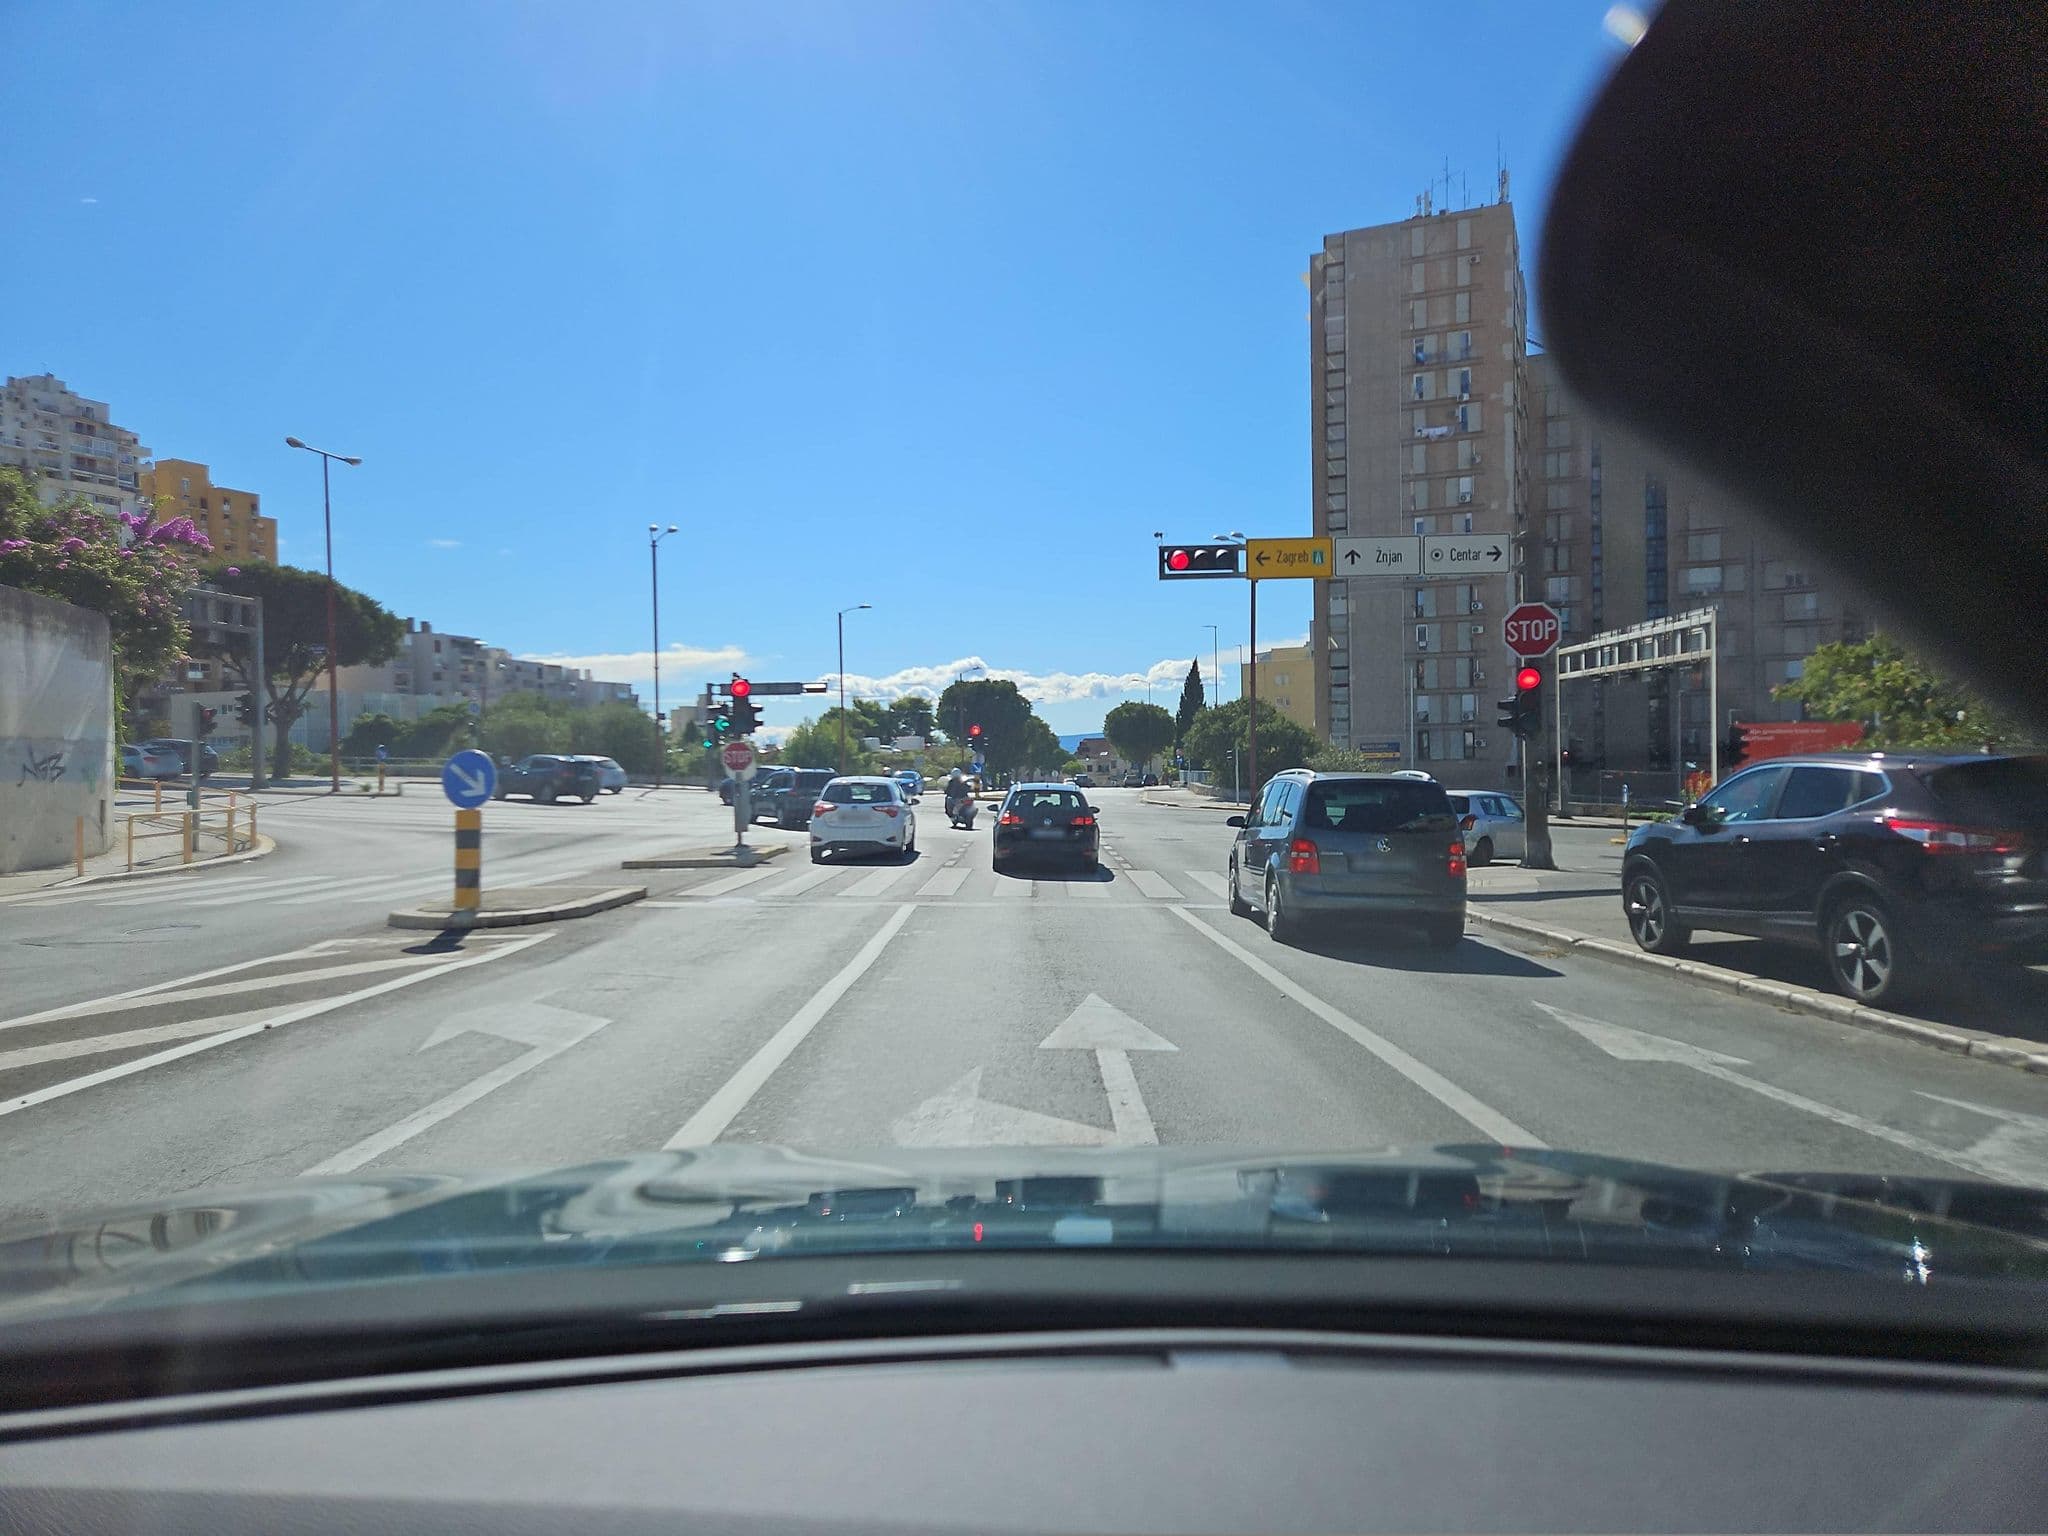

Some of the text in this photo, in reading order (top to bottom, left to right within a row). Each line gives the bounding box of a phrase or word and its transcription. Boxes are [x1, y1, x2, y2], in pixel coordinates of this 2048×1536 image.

[1276, 550, 1310, 566] Zagreb
[1375, 547, 1403, 566] Žnjan
[1450, 548, 1481, 561] Centar
[1507, 619, 1557, 642] STOP
[724, 750, 752, 762] STOP
